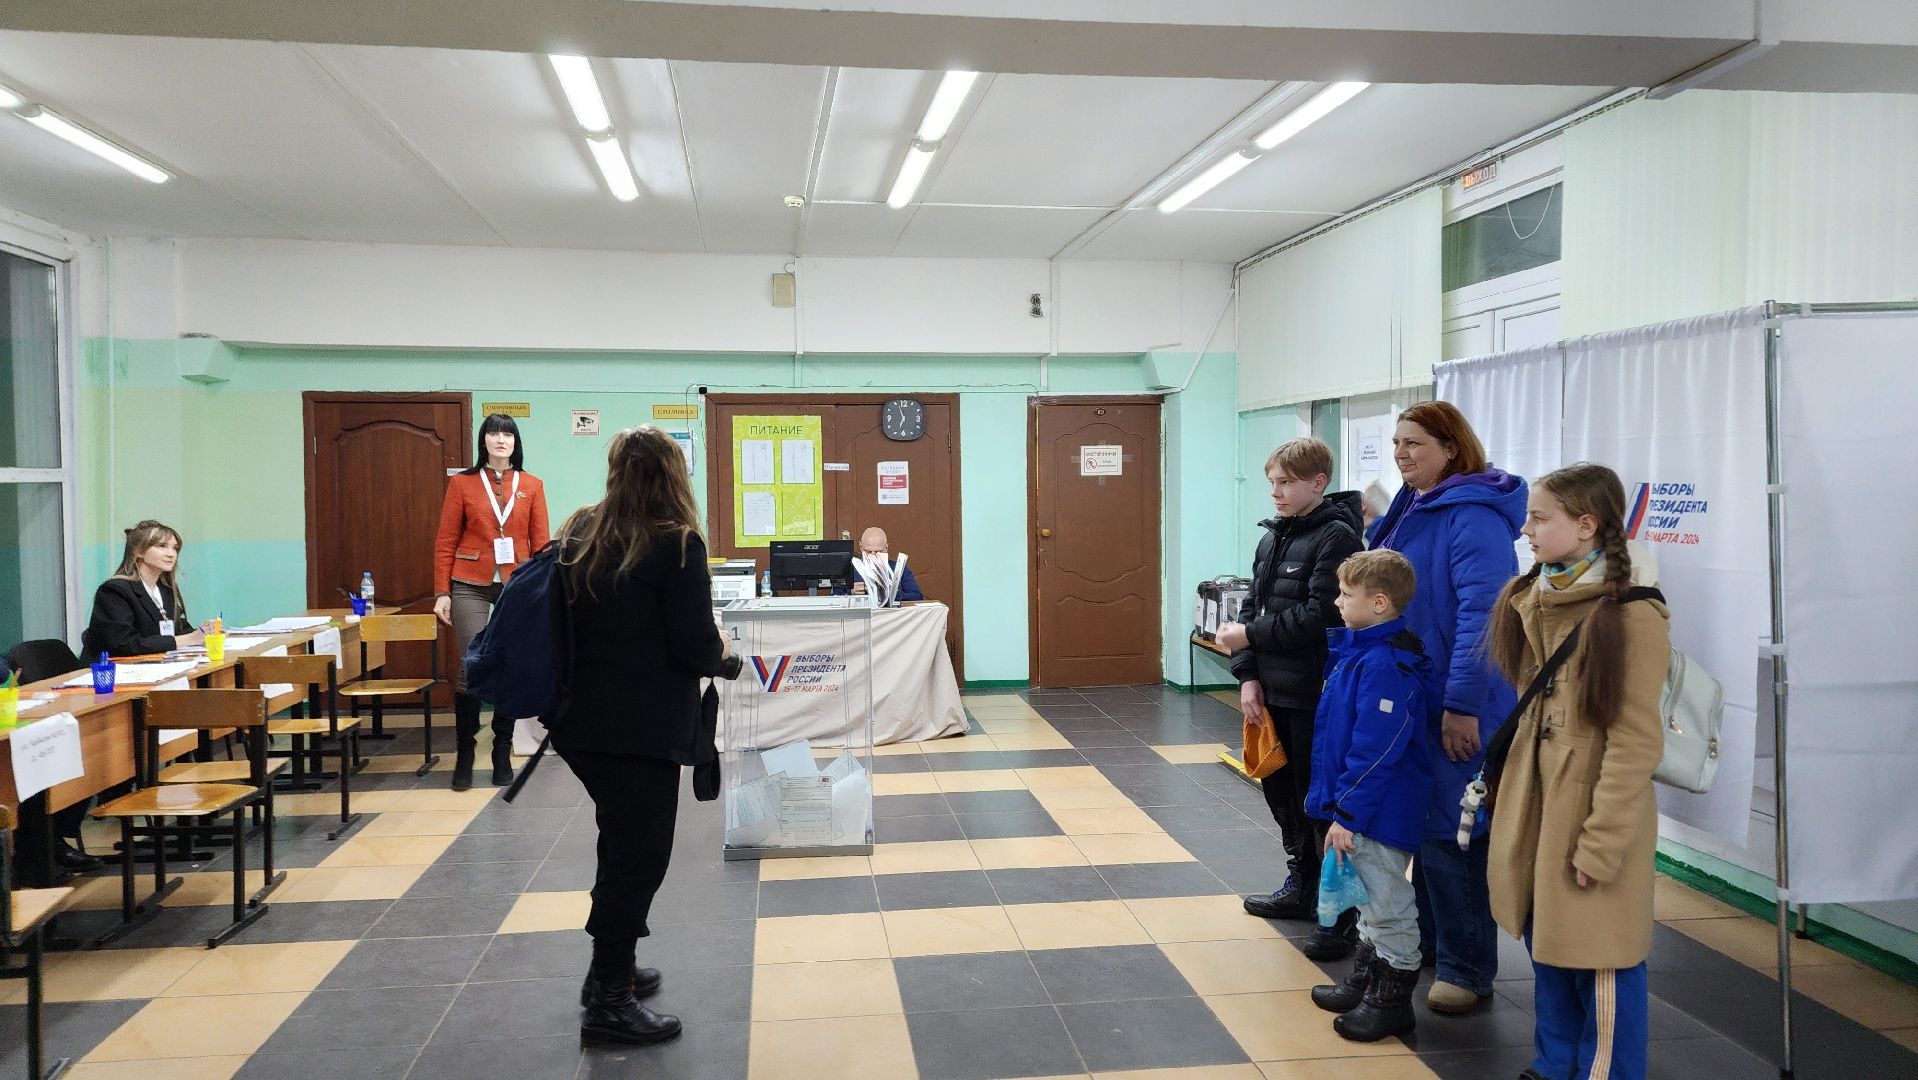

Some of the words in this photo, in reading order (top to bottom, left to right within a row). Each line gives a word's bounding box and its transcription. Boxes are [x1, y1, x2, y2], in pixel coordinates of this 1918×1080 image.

[1464, 164, 1496, 188] ВЫХОД
[750, 426, 803, 435] ПИТАНИЕ
[1681, 533, 1700, 545] 2024
[731, 626, 741, 640] 1
[796, 654, 835, 662] ВЫБОРЫ
[791, 664, 847, 673] ПРЕЗИДЕНТА
[786, 675, 822, 683] РОССИИ
[823, 684, 839, 692] 2024
